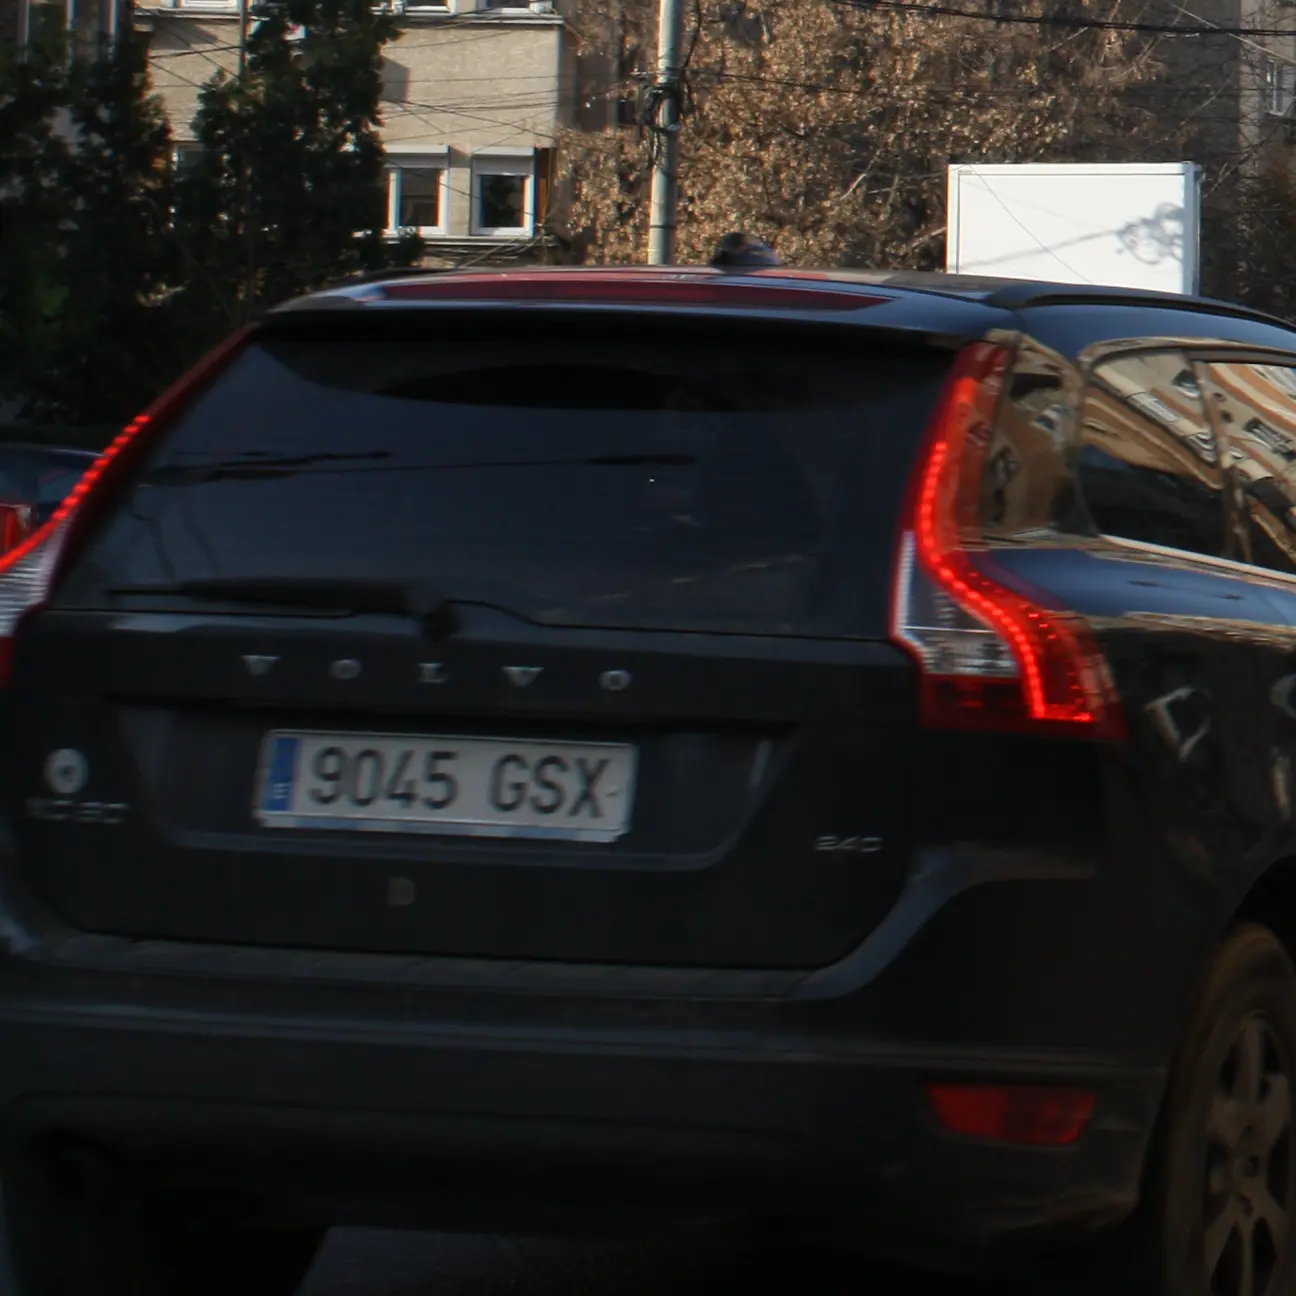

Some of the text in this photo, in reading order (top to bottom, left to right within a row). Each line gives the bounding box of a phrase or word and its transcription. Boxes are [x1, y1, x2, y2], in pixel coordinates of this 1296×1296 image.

[243, 653, 633, 693] VOLVO
[307, 745, 461, 811] 9045
[487, 753, 614, 820] GSX
